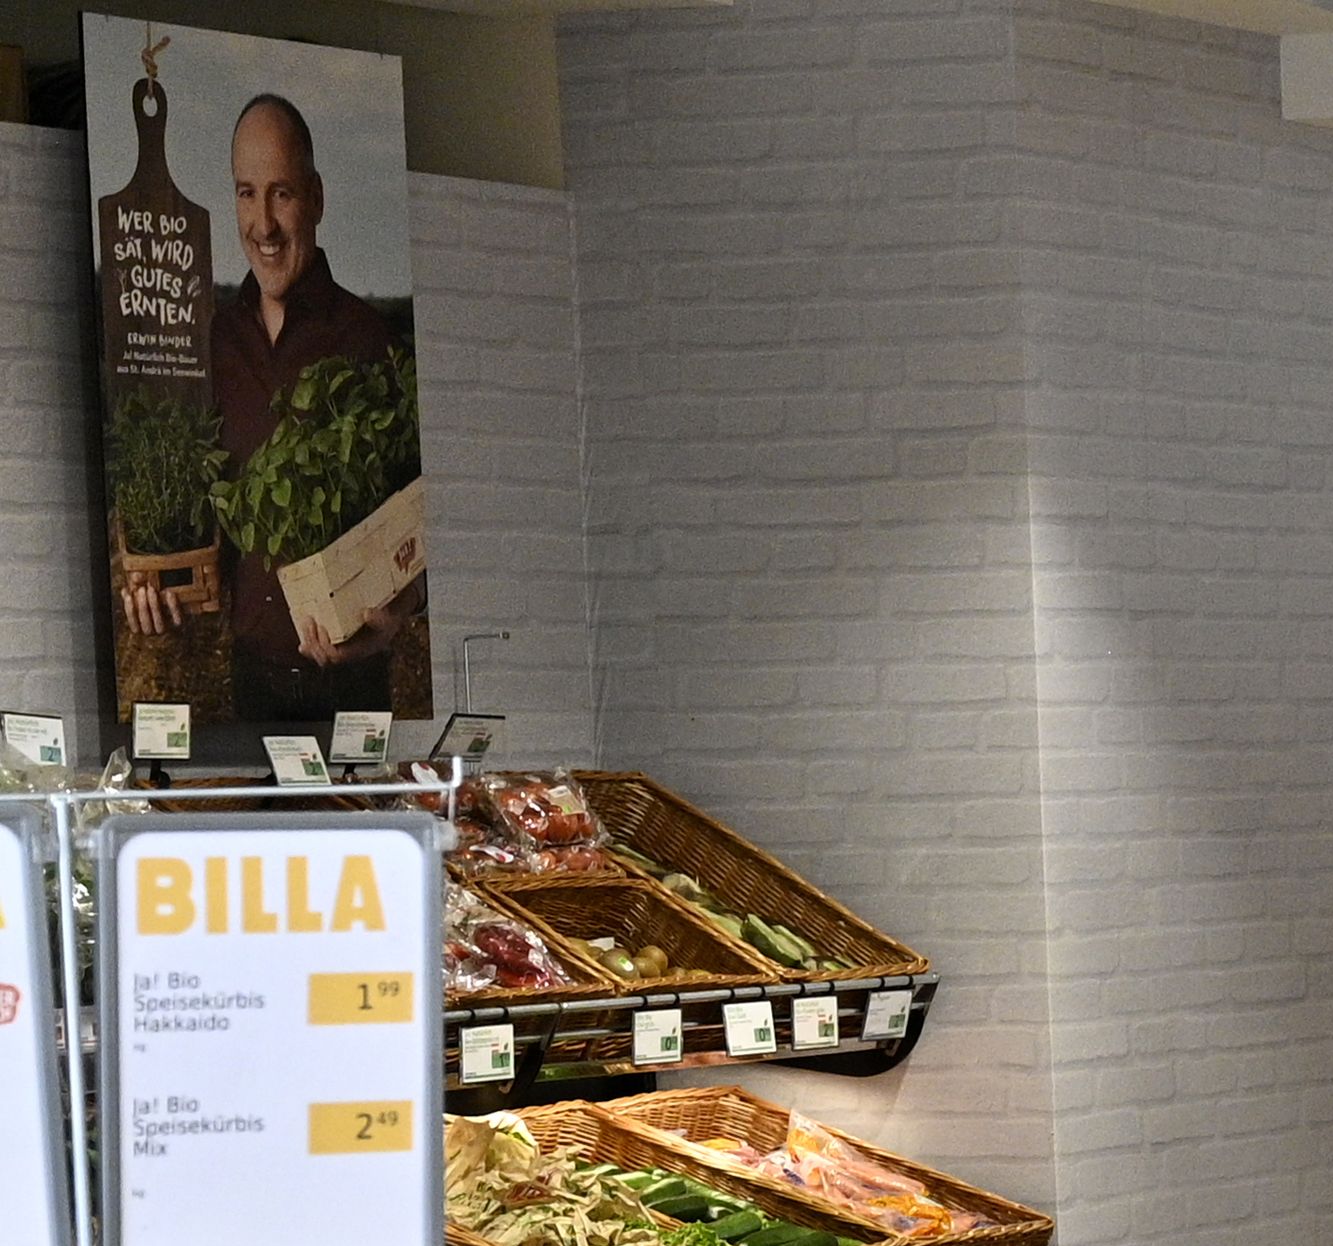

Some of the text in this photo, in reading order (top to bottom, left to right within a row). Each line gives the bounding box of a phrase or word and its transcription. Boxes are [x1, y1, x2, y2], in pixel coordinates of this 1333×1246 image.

[118, 206, 187, 235] WER BIO
[114, 236, 194, 271] SÄT, WIRD
[131, 265, 182, 298] GUTES
[119, 289, 195, 326] ERNTEN.
[128, 332, 192, 348] ERWIN BINDER
[136, 855, 387, 935] BILLA
[168, 971, 200, 990] Bio
[134, 992, 265, 1013] Speisekürbis
[134, 1014, 229, 1033] Hakkaido
[167, 1095, 199, 1114] Bio
[134, 1114, 265, 1138] Speisekürbis
[134, 1139, 167, 1157] Mix
